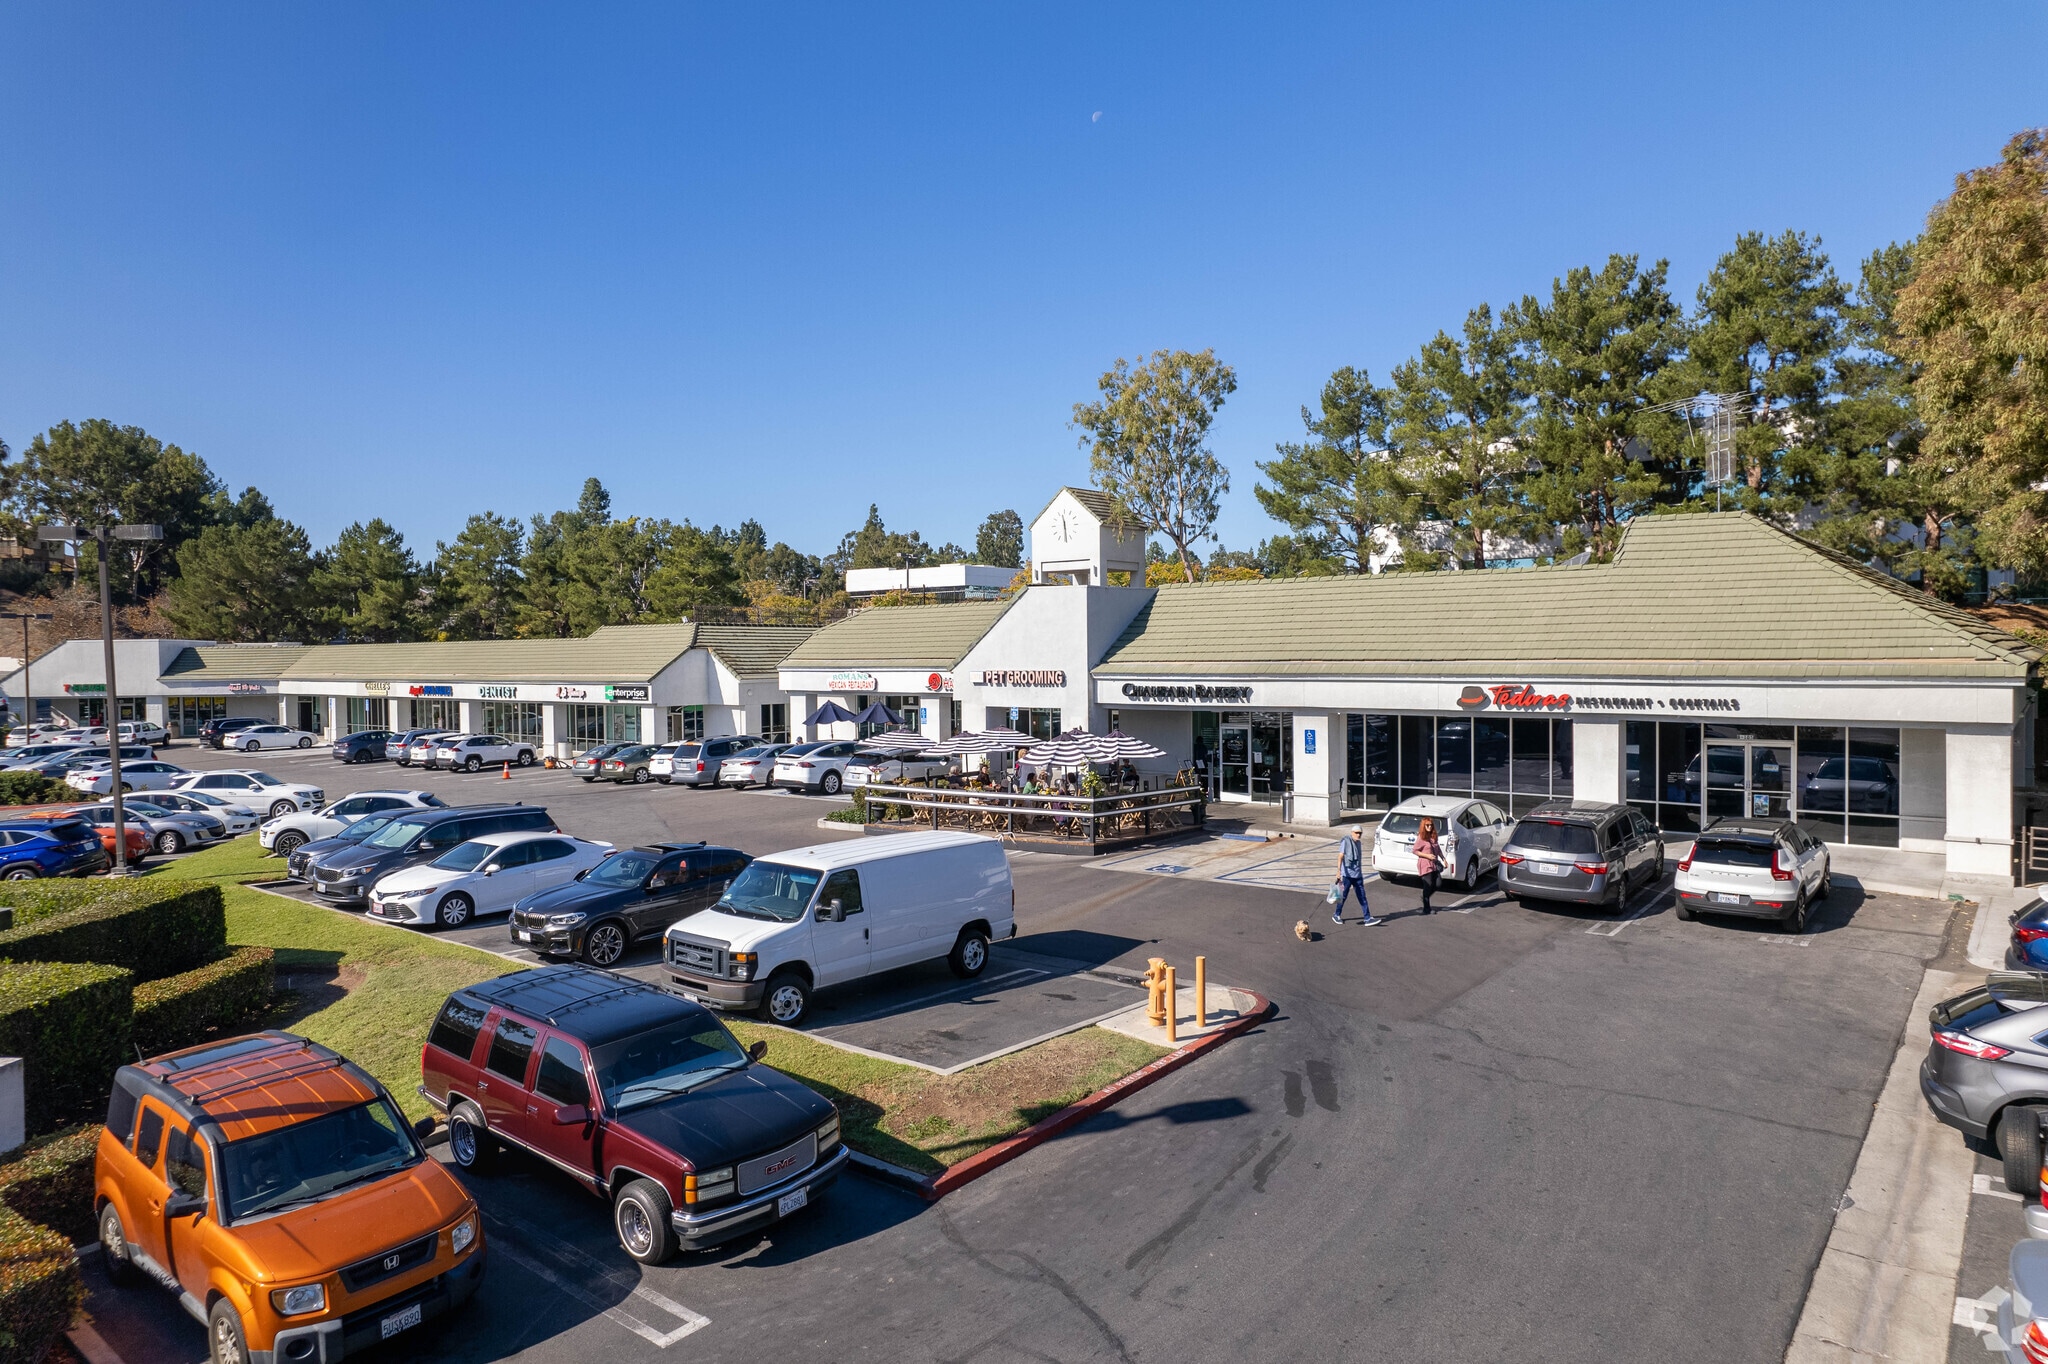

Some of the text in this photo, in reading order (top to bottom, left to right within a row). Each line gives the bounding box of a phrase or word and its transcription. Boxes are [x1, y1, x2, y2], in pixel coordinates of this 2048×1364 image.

[828, 681, 847, 689] MEXICAN
[985, 670, 1063, 685] PET GROOMING
[479, 686, 517, 698] DENTIST
[607, 688, 645, 699] enterprise
[1195, 684, 1250, 699] BAKERY
[1488, 683, 1740, 710] Fedoras RESTAURANT COCKTAILS
[765, 1153, 797, 1175] GMC
